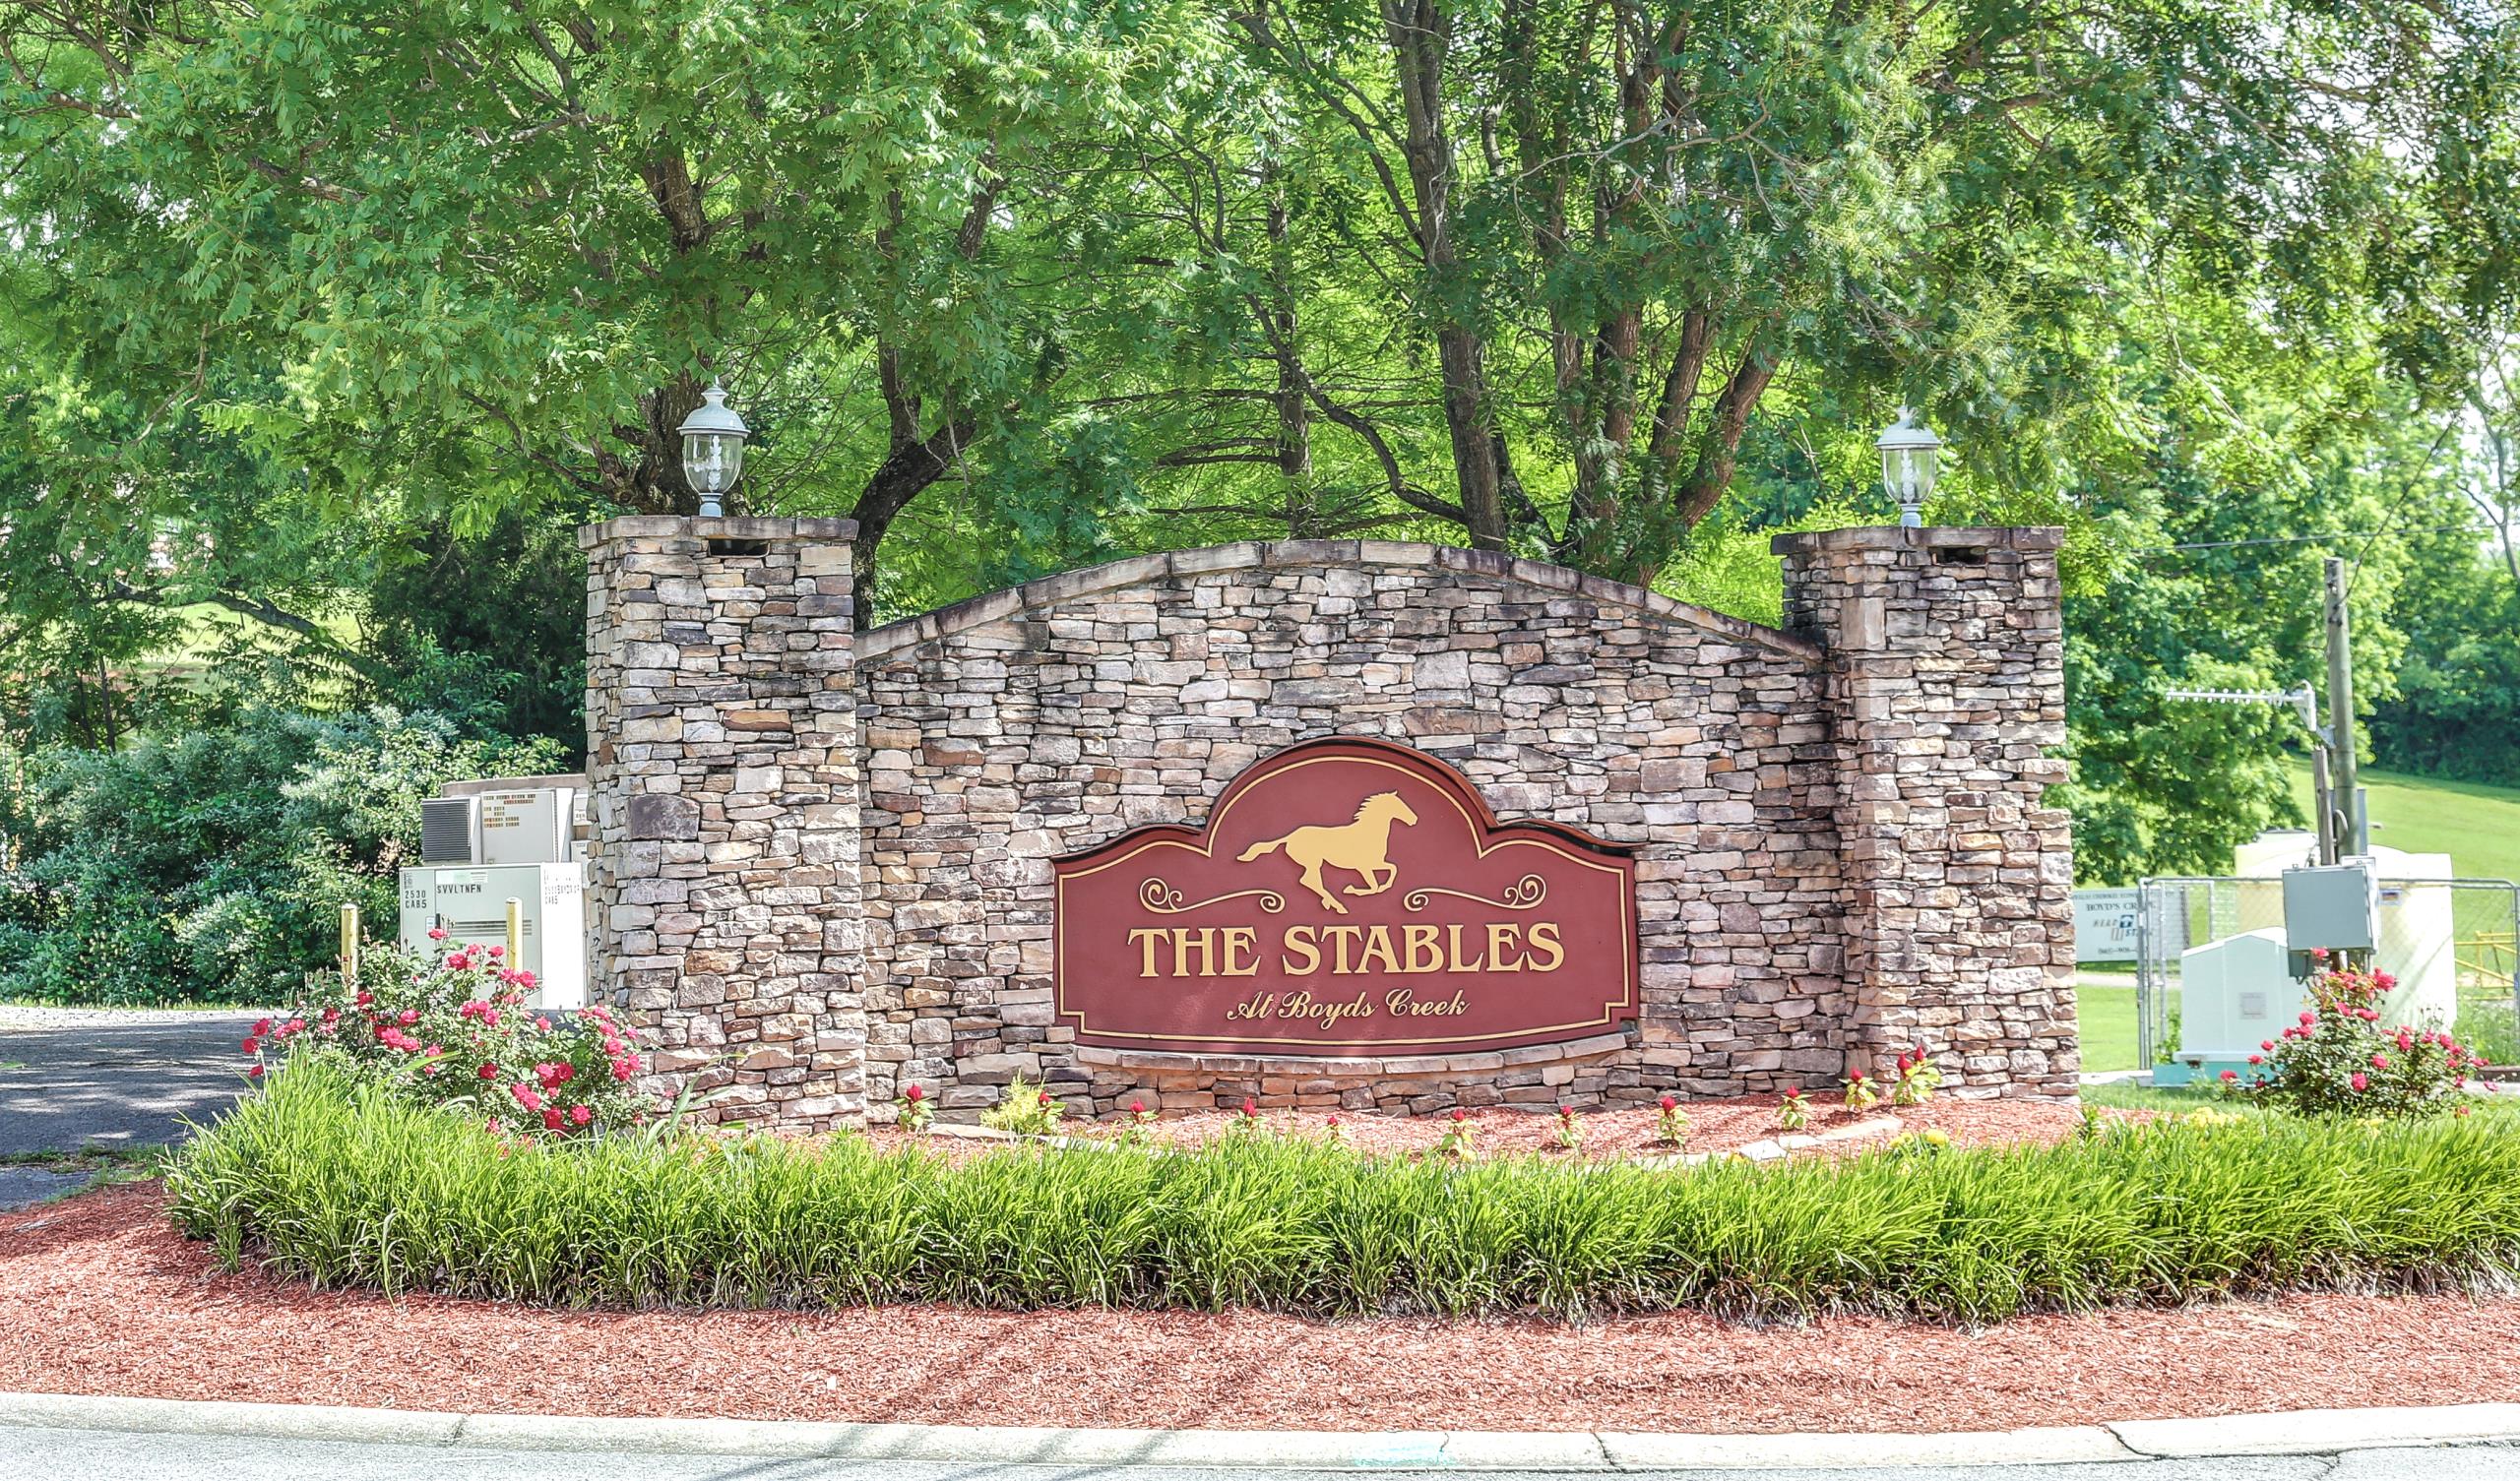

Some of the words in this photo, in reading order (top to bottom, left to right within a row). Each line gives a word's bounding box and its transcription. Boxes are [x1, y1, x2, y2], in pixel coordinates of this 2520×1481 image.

[405, 890, 426, 899] 2530
[405, 899, 427, 909] CAB5
[1127, 926, 1261, 977] THE
[1282, 922, 1565, 976] STABLES
[1227, 990, 1274, 1020] At
[1278, 990, 1377, 1030] Boyds
[1385, 988, 1471, 1017] Creek
